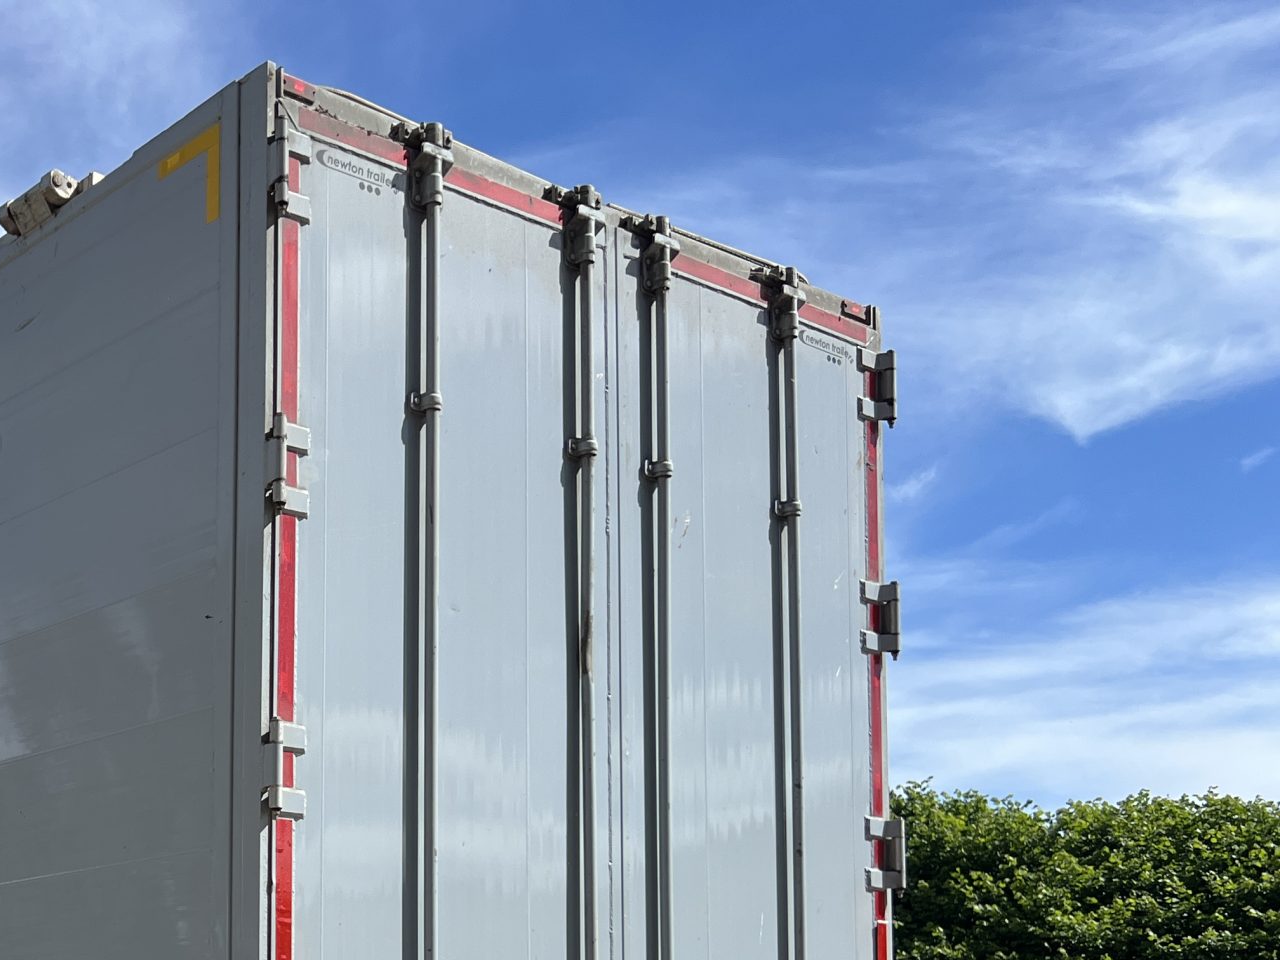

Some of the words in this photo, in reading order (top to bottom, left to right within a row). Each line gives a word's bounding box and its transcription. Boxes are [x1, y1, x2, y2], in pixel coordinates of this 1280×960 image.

[327, 155, 364, 176] newton
[367, 168, 398, 195] traile
[805, 335, 830, 350] newton
[832, 343, 854, 364] trailers
